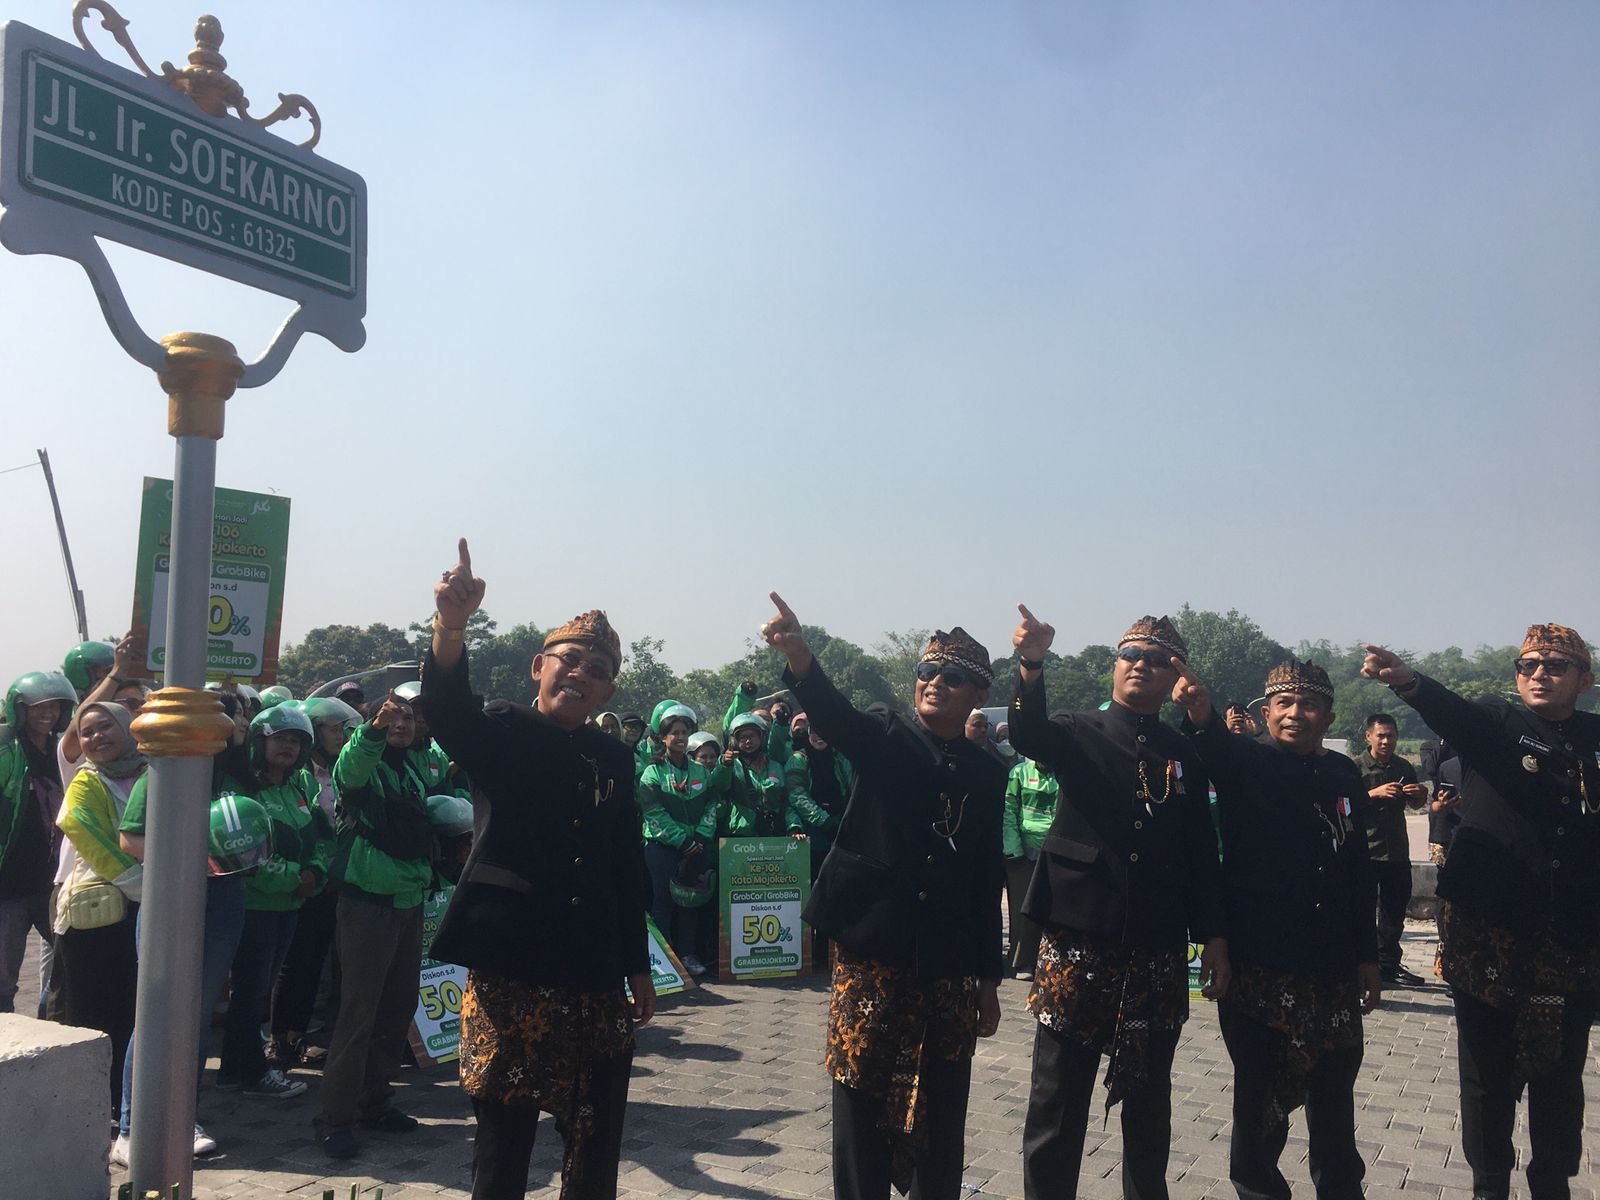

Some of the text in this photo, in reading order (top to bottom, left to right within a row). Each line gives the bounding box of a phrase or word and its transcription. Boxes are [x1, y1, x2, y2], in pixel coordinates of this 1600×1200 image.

[42, 78, 347, 236] JL. Ir. SOEKARNO
[112, 173, 173, 220] KODE
[182, 198, 223, 237] POS
[243, 222, 296, 263] 61325
[215, 524, 240, 538] 106
[212, 541, 266, 556] ojokerto
[216, 564, 266, 579] GrabBike
[208, 595, 251, 636] 0%
[224, 833, 254, 850] Grab
[733, 843, 756, 853] Grab
[731, 875, 798, 886] Kota Mojokerto
[733, 891, 799, 901] GrabCar GrabBike
[751, 904, 772, 912] Diskon
[742, 914, 793, 945] 50%
[422, 969, 444, 981] Diskon
[419, 980, 463, 1020] 50
